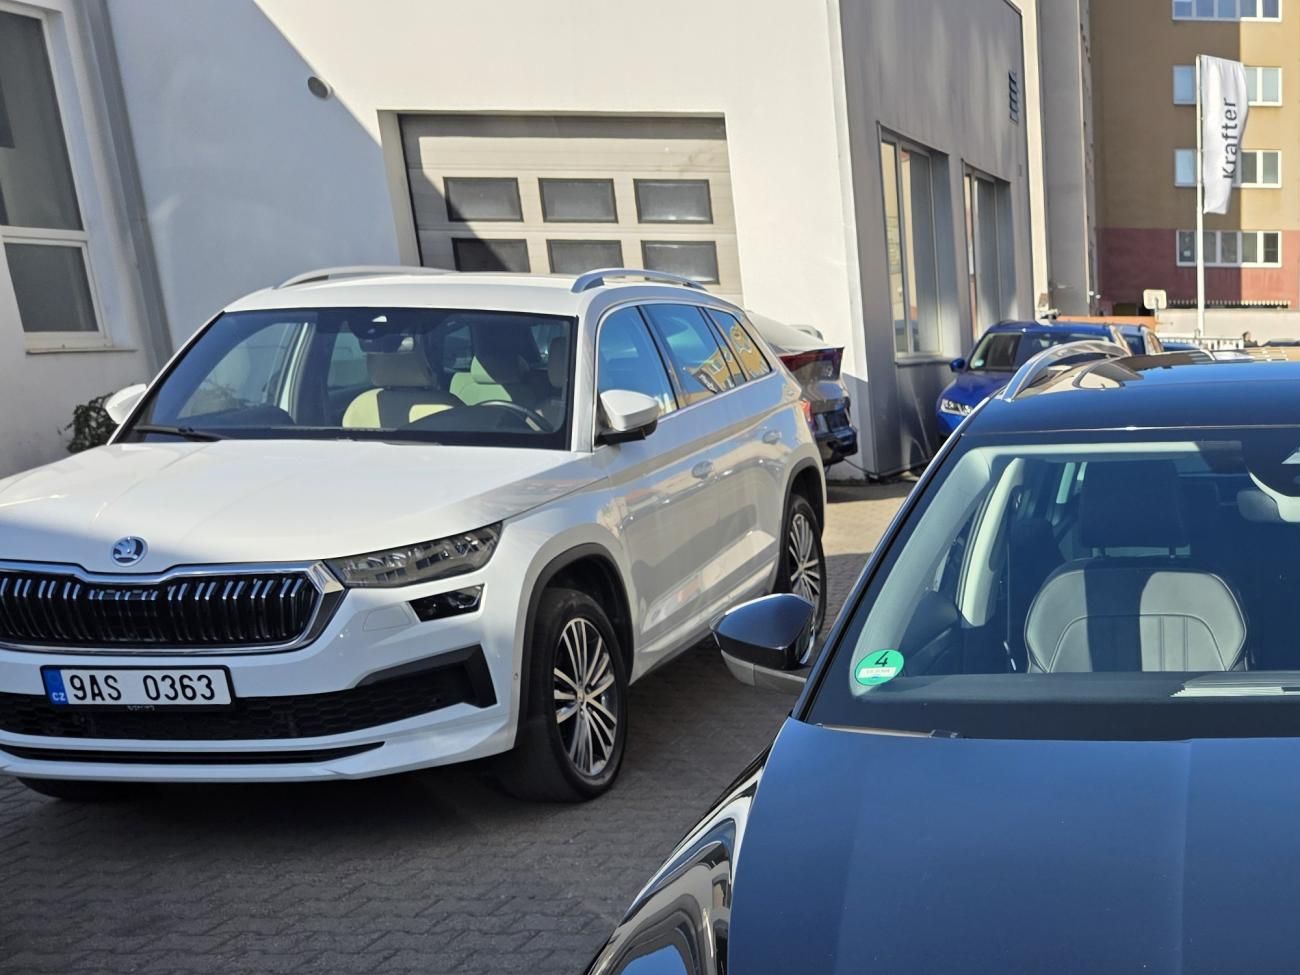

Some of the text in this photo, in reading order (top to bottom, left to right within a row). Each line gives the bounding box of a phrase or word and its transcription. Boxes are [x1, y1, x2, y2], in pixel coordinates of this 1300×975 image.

[1221, 97, 1238, 179] Krafter
[874, 650, 890, 667] 4
[52, 691, 66, 701] CZ
[69, 674, 215, 701] 9AS 0363
